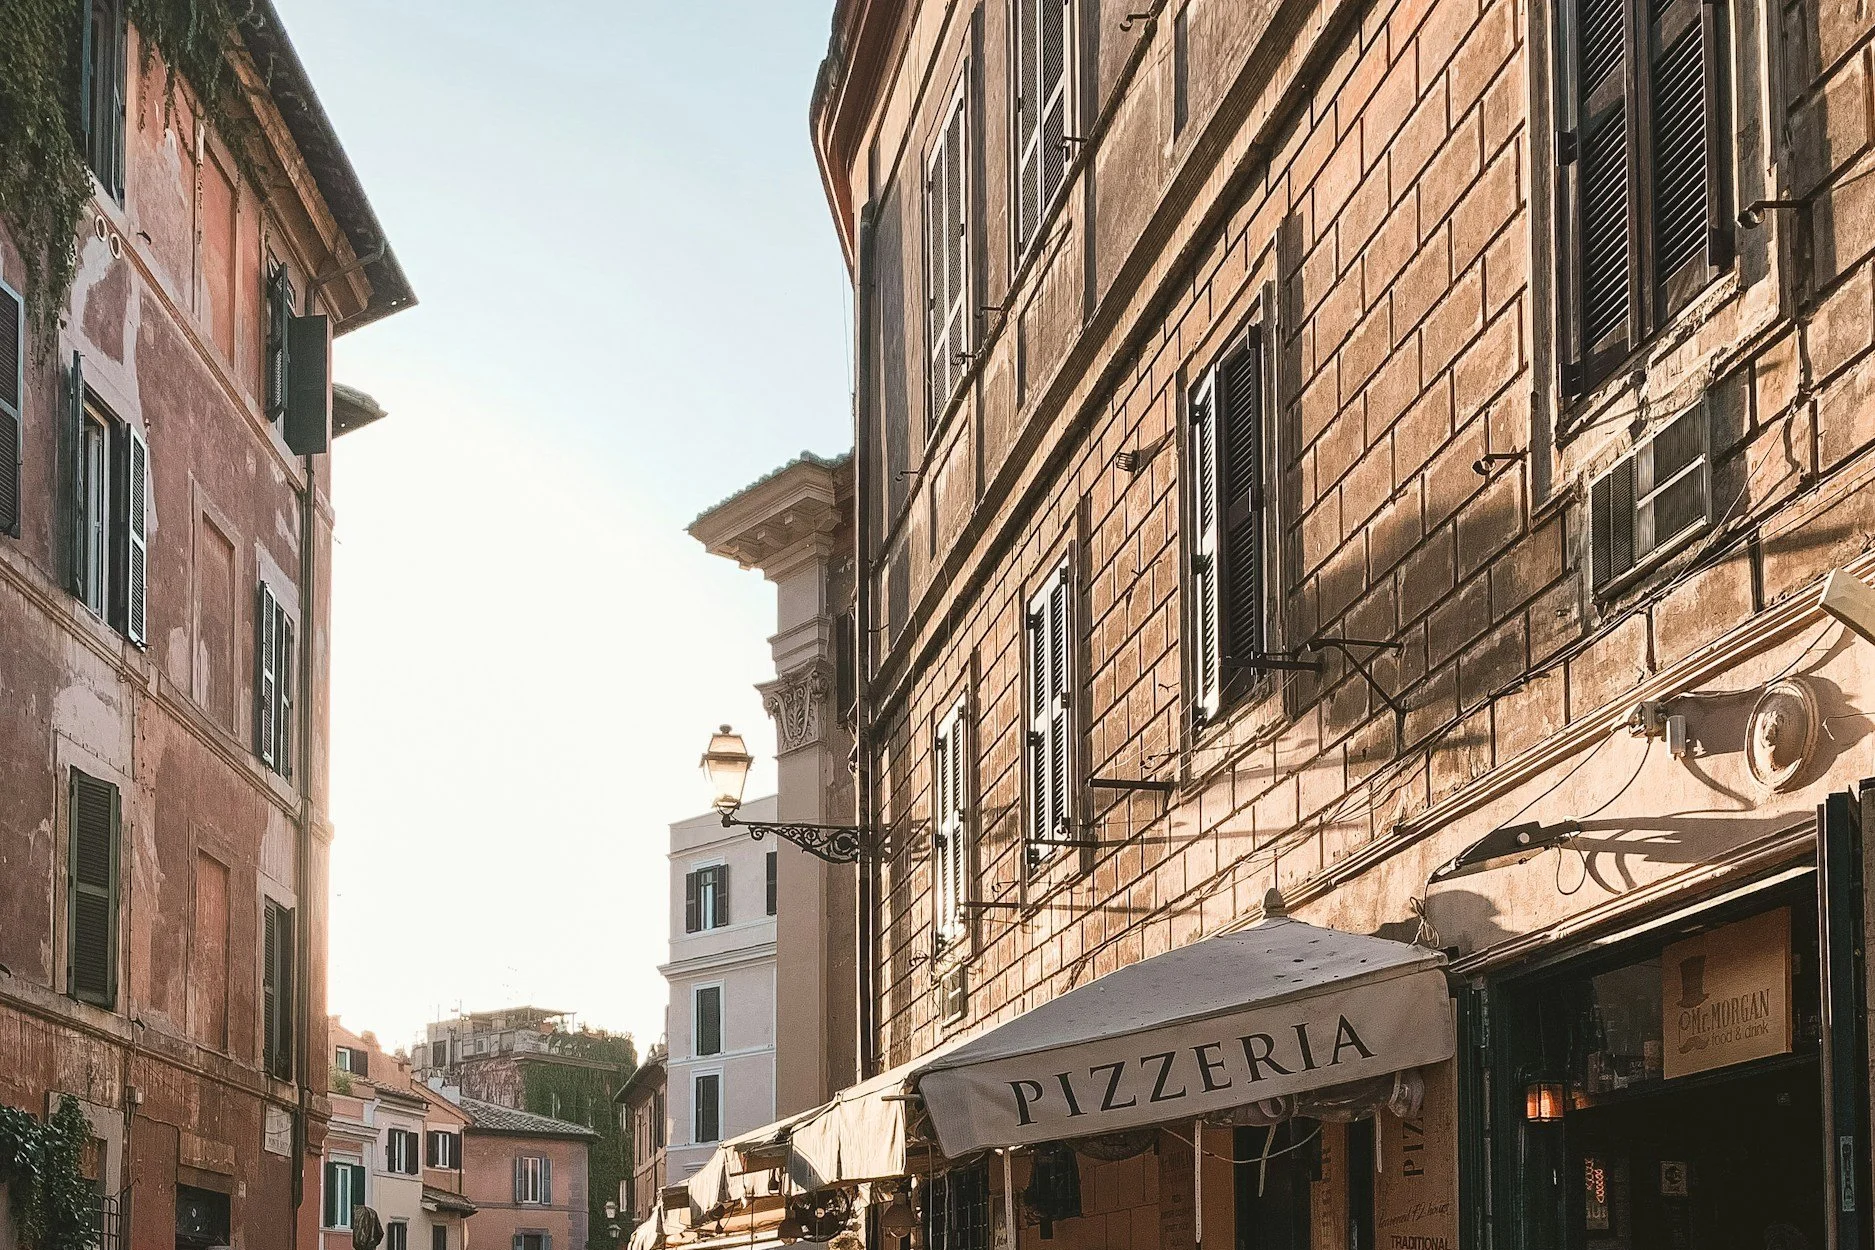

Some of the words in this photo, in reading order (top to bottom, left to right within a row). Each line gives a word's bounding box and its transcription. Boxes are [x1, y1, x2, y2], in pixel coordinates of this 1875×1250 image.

[1711, 1031, 1733, 1047] food
[1735, 1027, 1742, 1041] &
[1744, 1020, 1769, 1039] drink
[1005, 1013, 1377, 1127] PIZZERIA
[1402, 1105, 1424, 1177] PIZ
